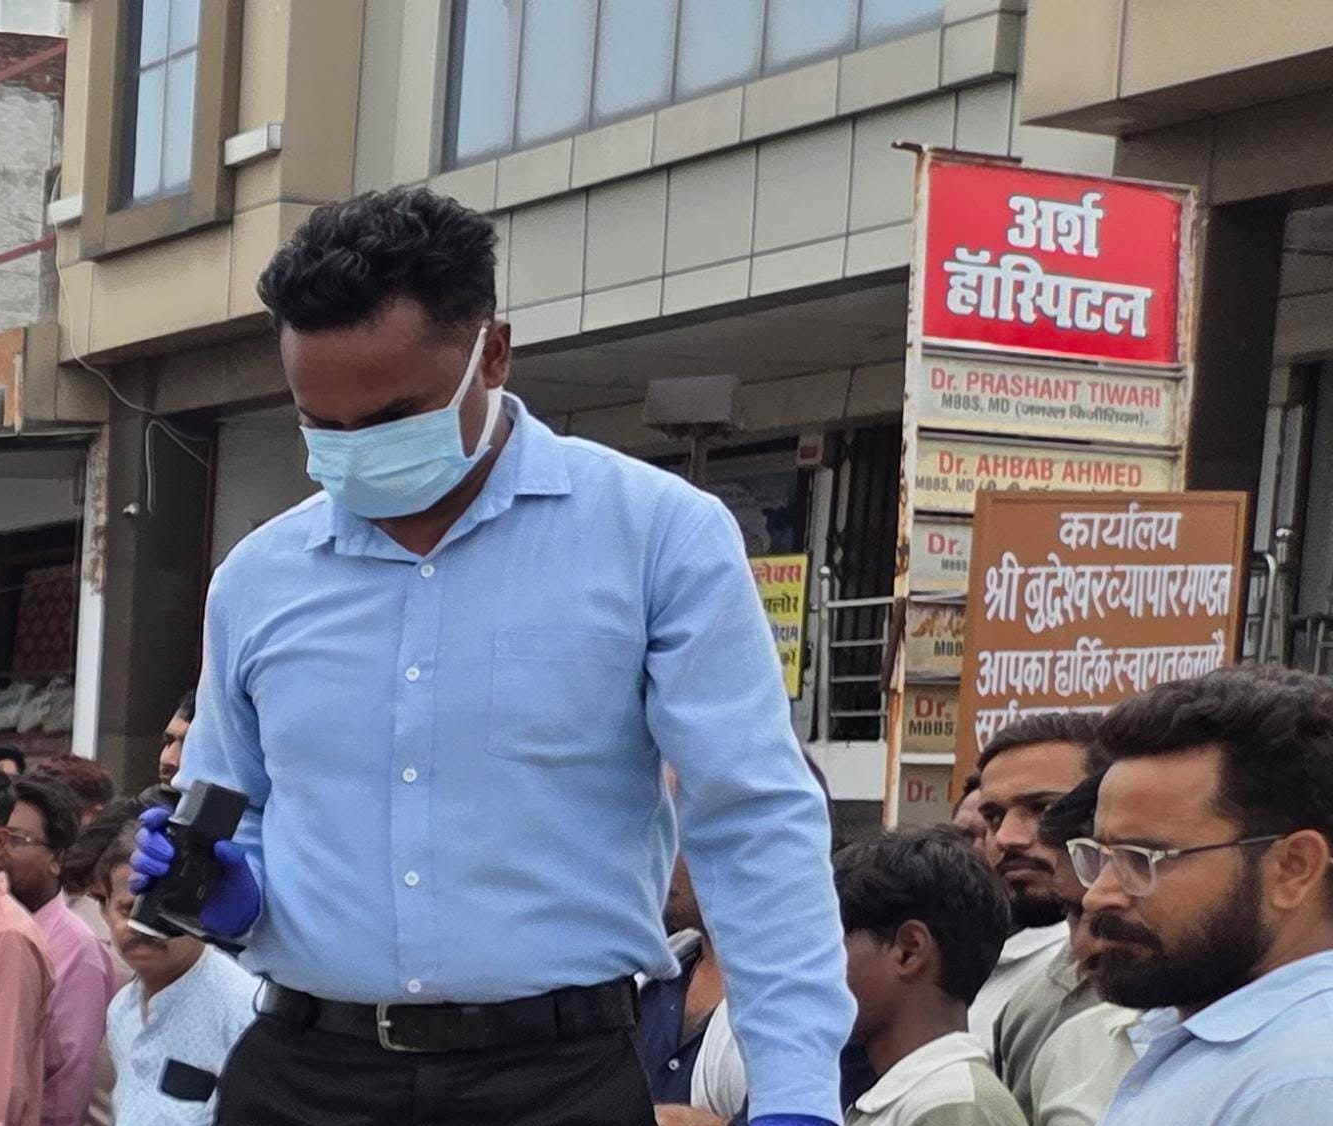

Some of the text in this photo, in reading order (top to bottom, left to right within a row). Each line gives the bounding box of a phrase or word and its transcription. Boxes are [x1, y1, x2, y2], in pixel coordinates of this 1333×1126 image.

[1007, 192, 1103, 258] अर्श
[943, 247, 1153, 338] हॉस्पिटल
[930, 368, 1161, 408] Dr. PRASHANT TIWARI
[988, 396, 1010, 414] MD
[938, 451, 967, 475] Dr.
[976, 455, 1054, 481] AHBAB
[1061, 461, 1143, 489] AHMED
[955, 479, 975, 492] MD
[927, 533, 964, 556] Dr.
[1058, 502, 1183, 550] कार्यालय
[984, 551, 1025, 622] श्री
[1107, 564, 1185, 618] व्यापार
[1181, 564, 1234, 617] मण्डल
[977, 650, 1053, 697] आपका
[1055, 636, 1113, 699] हार्दिक
[1114, 646, 1179, 694] स्वागत
[914, 694, 951, 718] Dr.
[905, 779, 938, 802] Dr.
